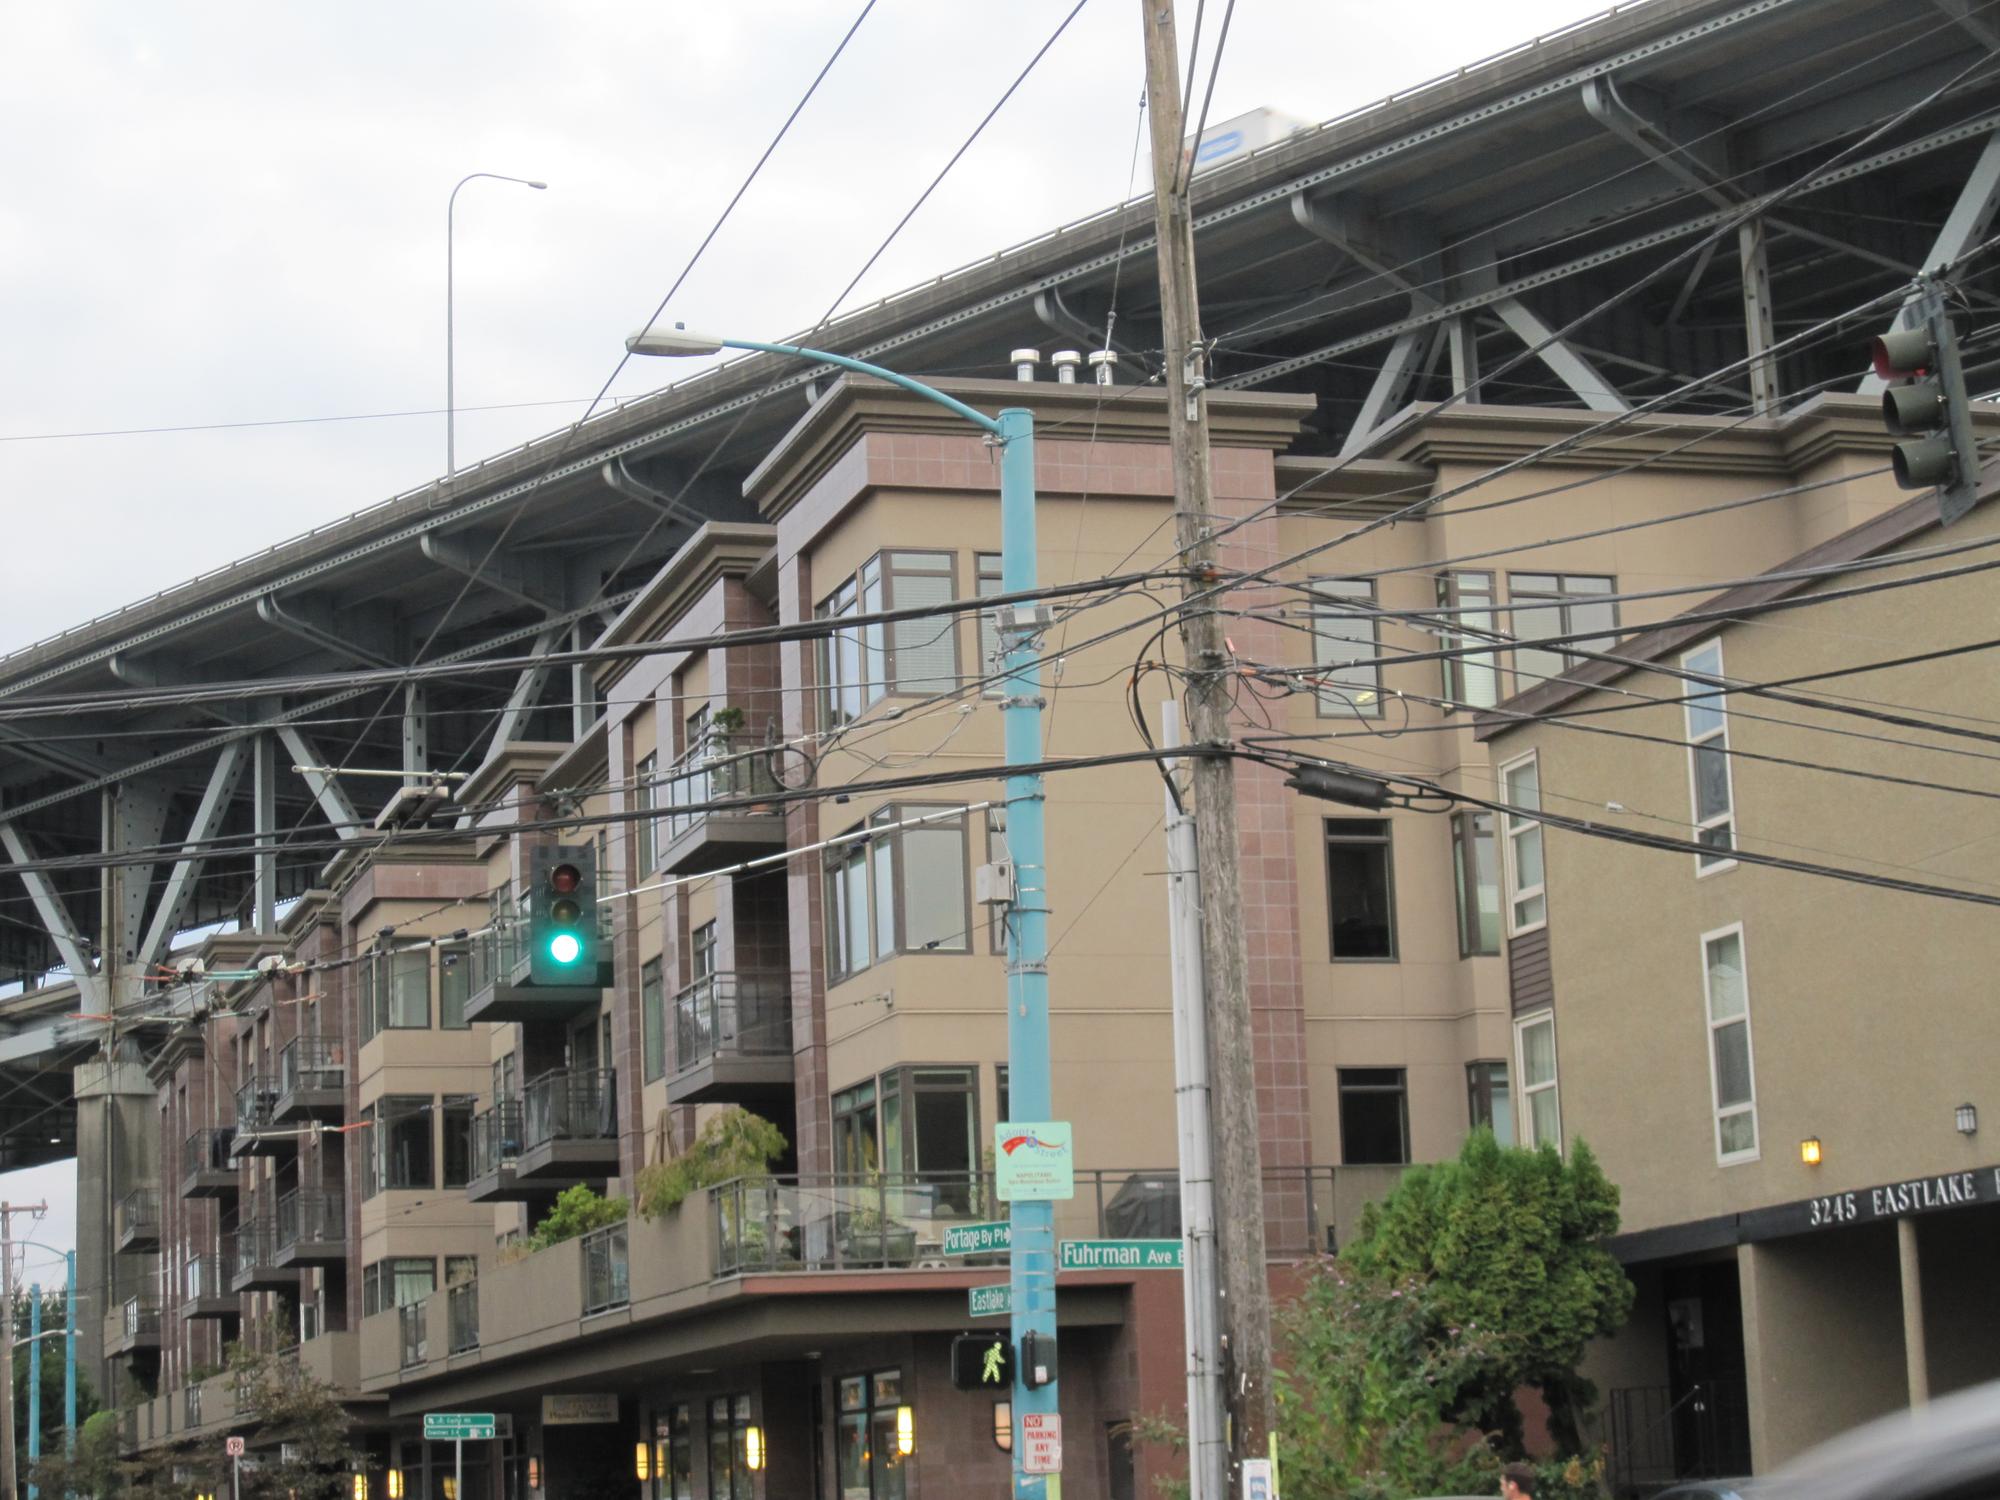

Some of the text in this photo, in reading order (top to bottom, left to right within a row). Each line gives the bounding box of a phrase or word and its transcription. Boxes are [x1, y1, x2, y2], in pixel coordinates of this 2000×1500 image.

[1810, 1193, 1857, 1226] 3245
[1872, 1172, 1976, 1216] EASTLAKE
[945, 1228, 980, 1252] Portage
[981, 1229, 992, 1246] By
[1063, 1243, 1140, 1265] Fuhrman
[1147, 1249, 1172, 1264] Ave
[972, 1290, 1004, 1312] Eastlake
[1025, 1415, 1041, 1427] NO
[1025, 1431, 1057, 1440] PARKING
[1035, 1443, 1048, 1452] ANY
[1034, 1455, 1051, 1464] TIME
